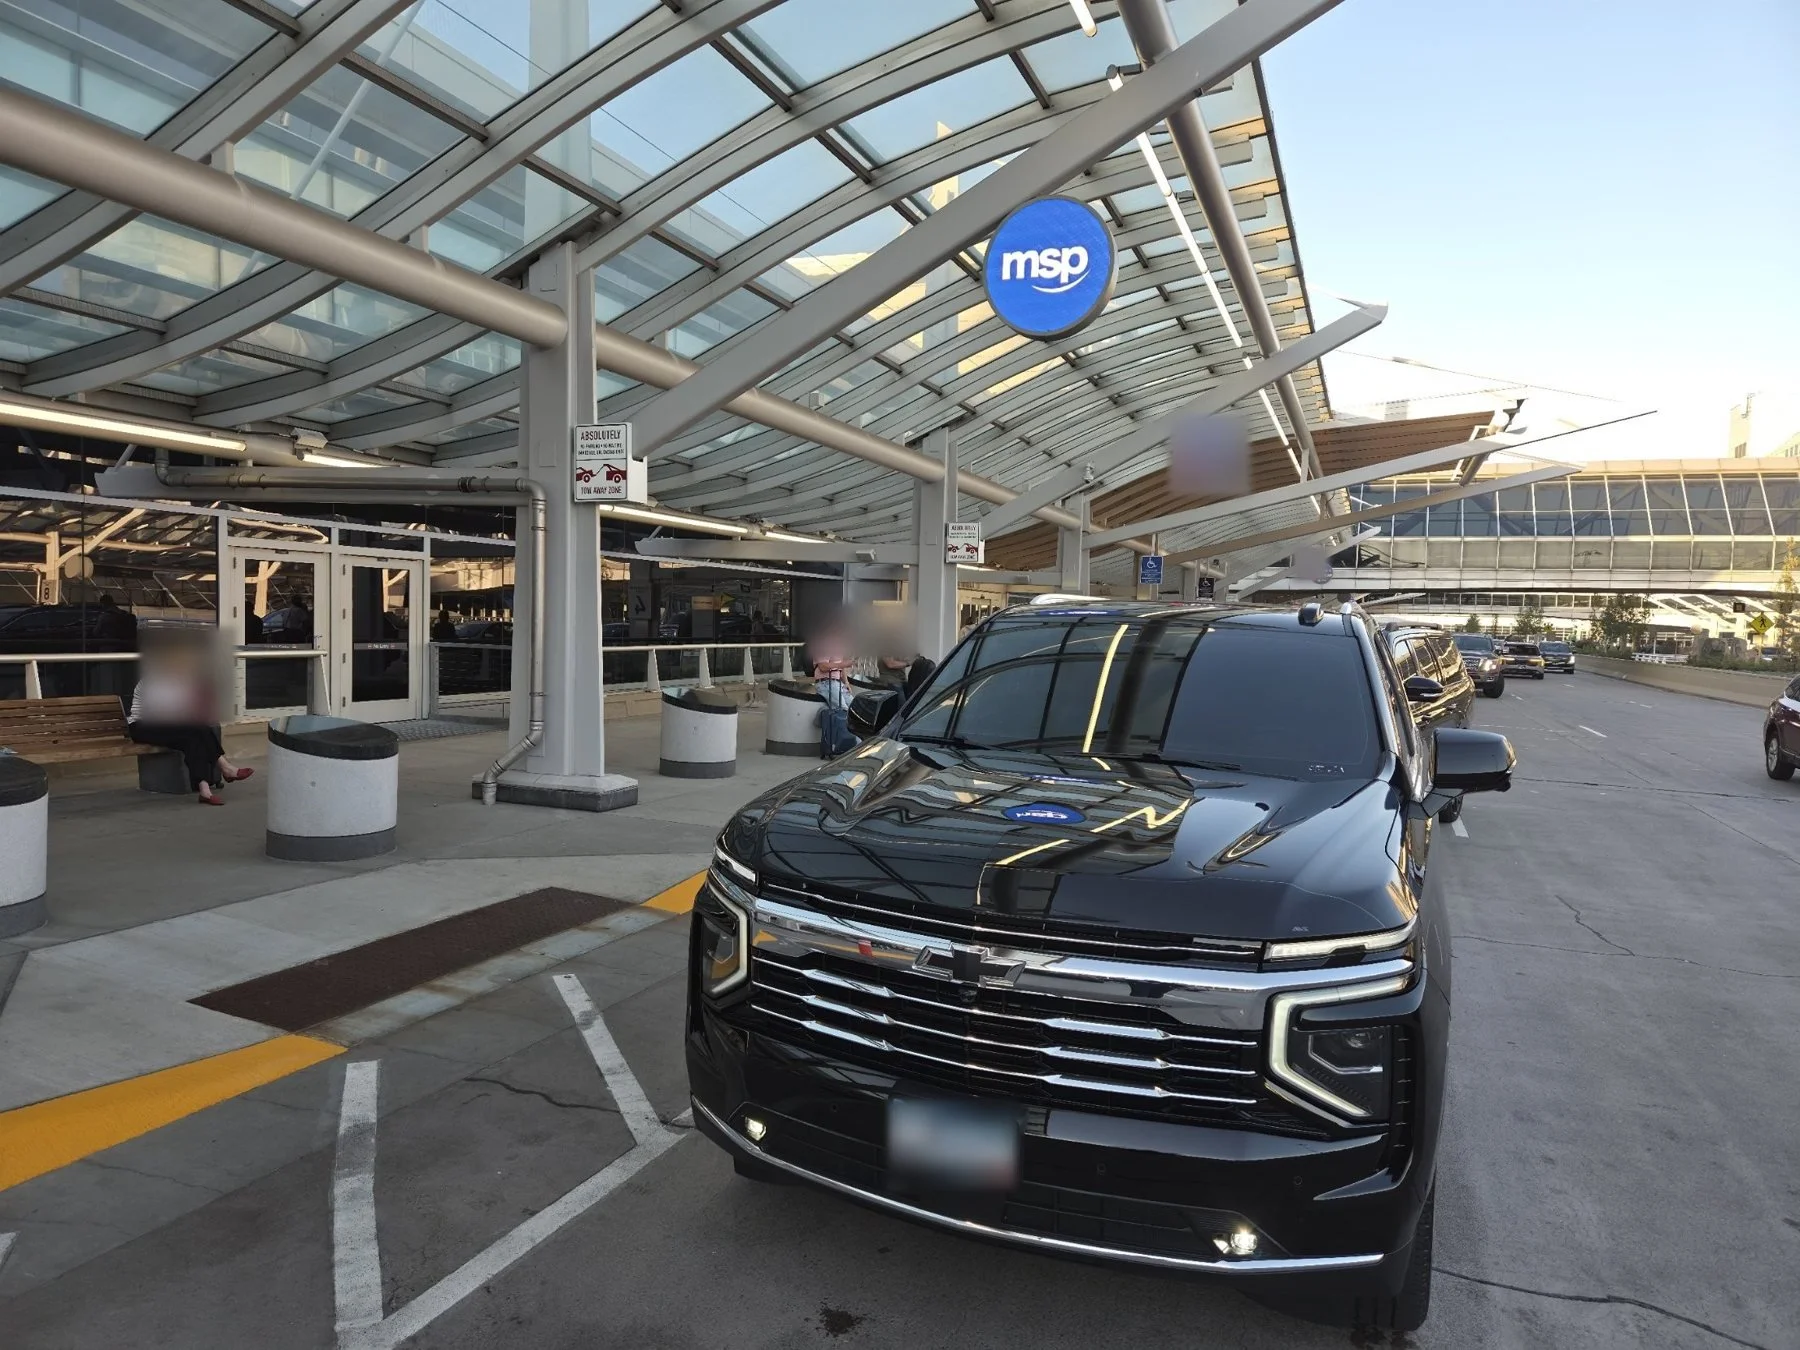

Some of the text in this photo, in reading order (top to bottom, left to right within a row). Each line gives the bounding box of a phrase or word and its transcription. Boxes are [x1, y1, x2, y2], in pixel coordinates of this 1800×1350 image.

[1002, 246, 1089, 284] msp
[581, 430, 621, 441] ABSOLUTELY
[581, 485, 622, 495] TOW AWAY ZONE
